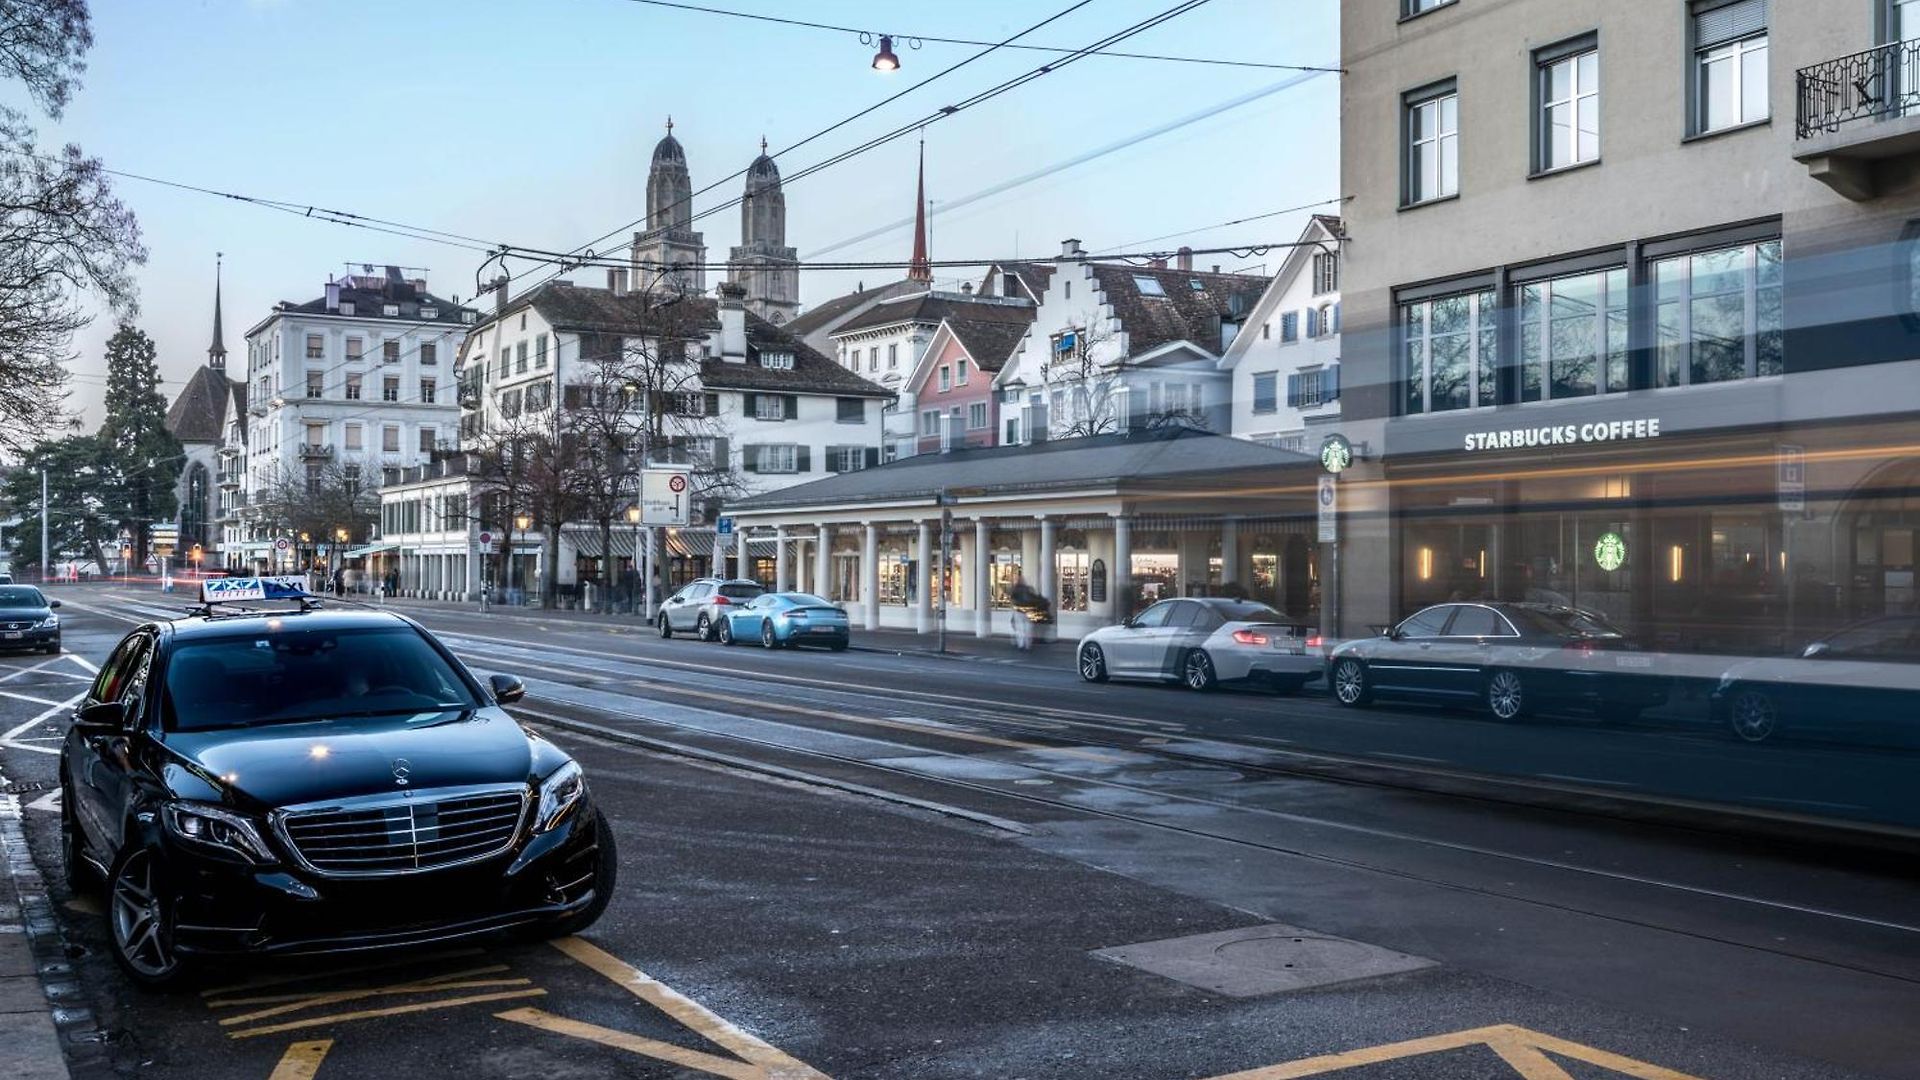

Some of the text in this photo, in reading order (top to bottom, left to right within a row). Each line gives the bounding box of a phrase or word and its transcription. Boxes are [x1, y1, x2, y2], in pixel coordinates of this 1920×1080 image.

[1464, 418, 1660, 450] STARBUCKS COFFEE
[262, 582, 304, 593] TAXI
